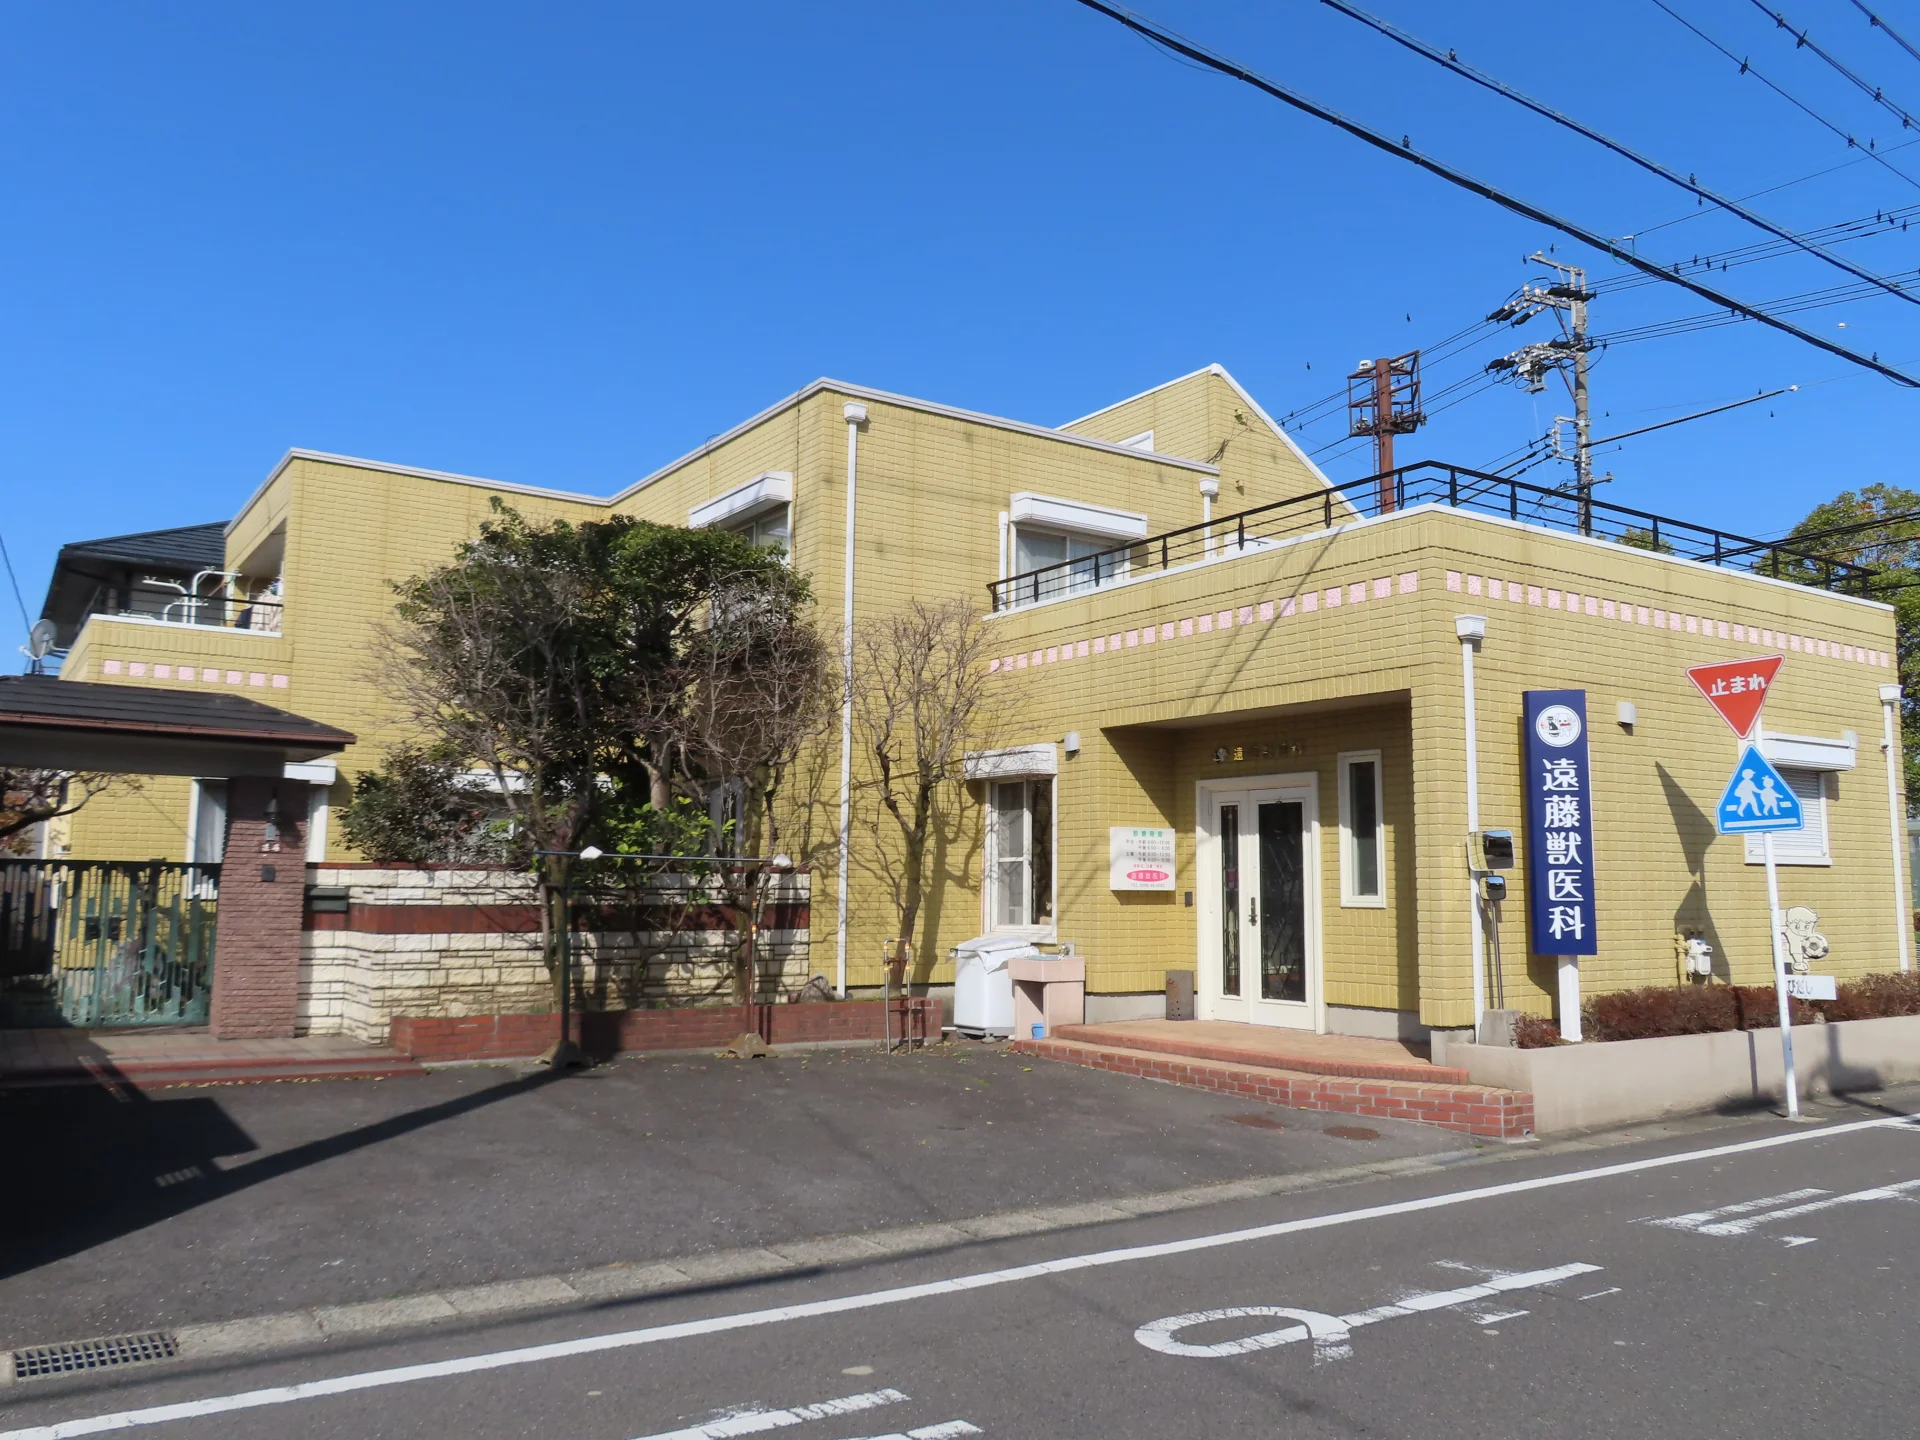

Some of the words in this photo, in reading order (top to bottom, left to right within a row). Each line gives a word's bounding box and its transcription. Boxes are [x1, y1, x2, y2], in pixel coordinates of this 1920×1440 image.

[1710, 674, 1767, 696] 止まれ
[1542, 757, 1586, 941] 遠藤獣医科
